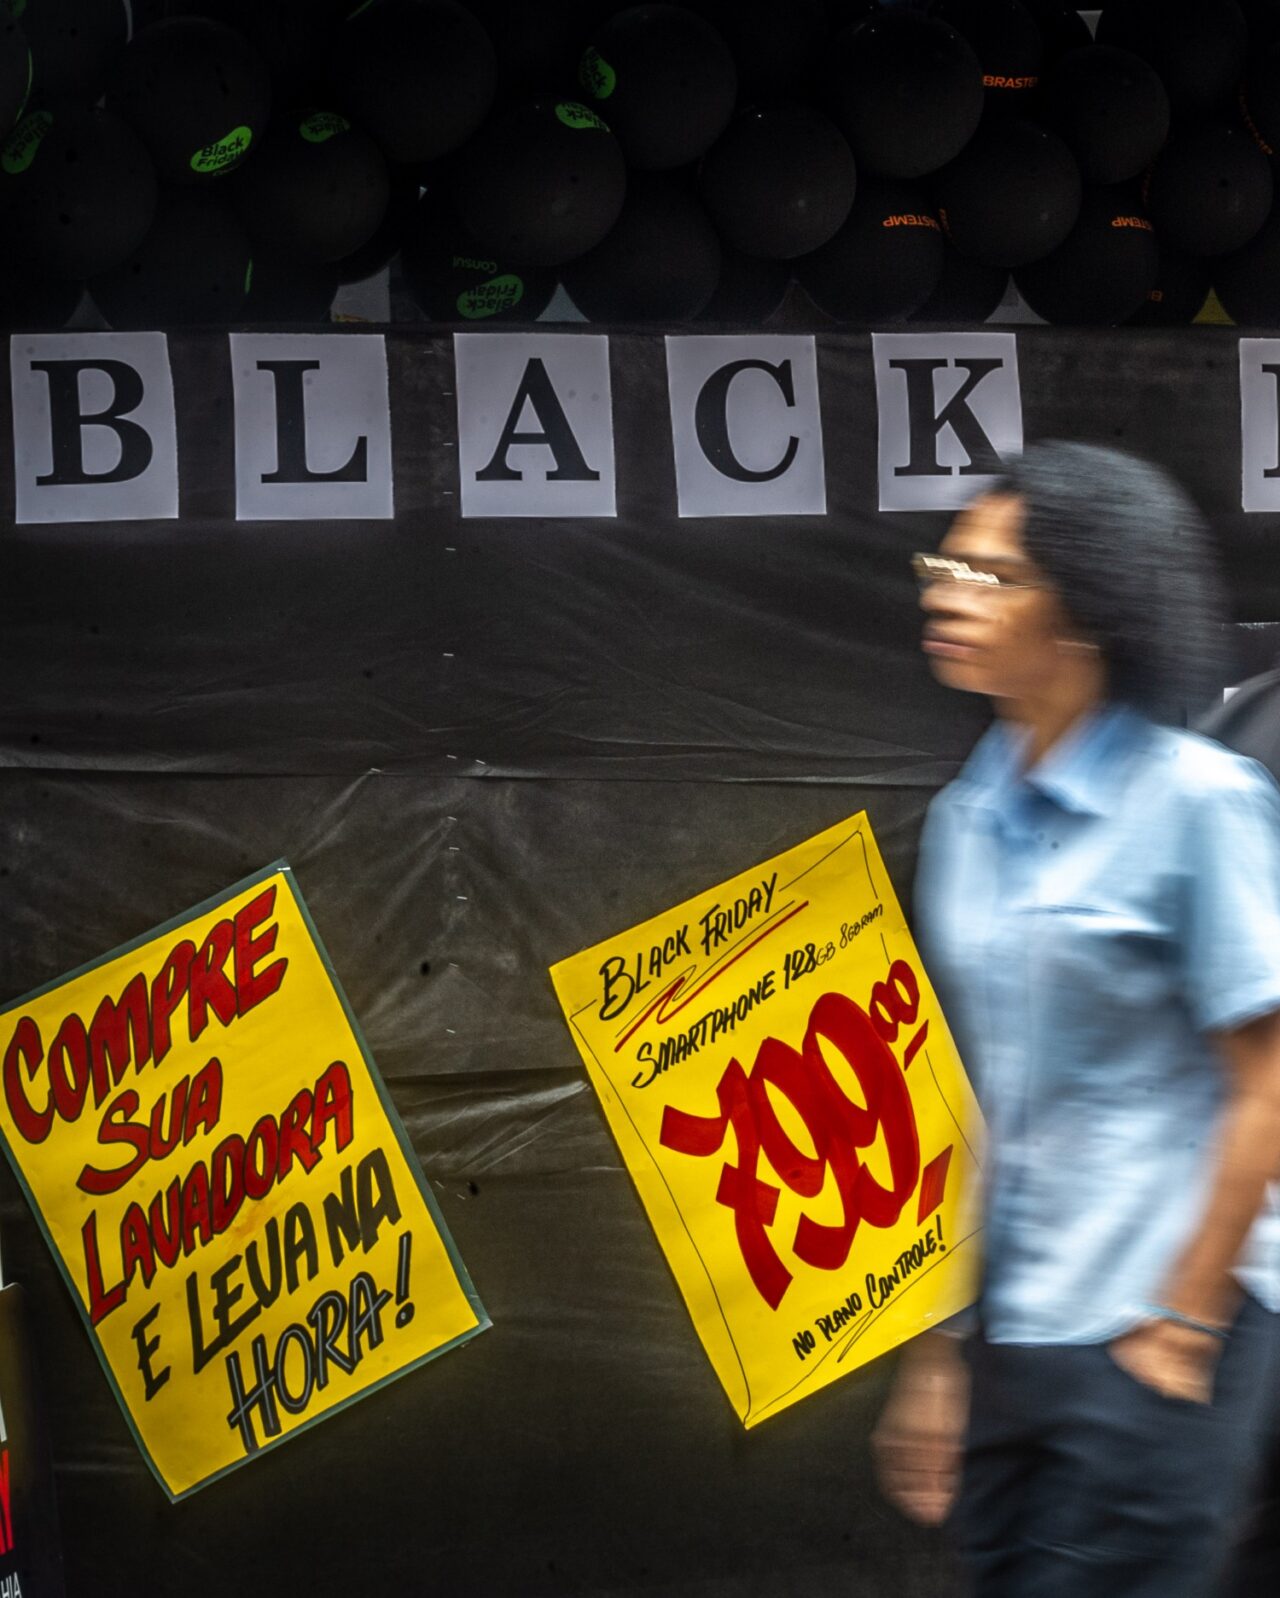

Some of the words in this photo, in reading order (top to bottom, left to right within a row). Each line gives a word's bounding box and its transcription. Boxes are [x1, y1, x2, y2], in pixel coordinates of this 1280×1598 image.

[201, 136, 243, 158] Black
[30, 356, 1005, 486] BLACK
[3, 884, 289, 1144] COMPRE
[600, 925, 691, 1021] BLACK
[699, 872, 778, 956] FRIDAY
[631, 970, 776, 1089] SMARTPHONE
[76, 1056, 223, 1196] SUA
[82, 1060, 354, 1330] LAVADORA
[130, 1303, 173, 1402] E
[187, 1202, 319, 1374] LEVA
[322, 1147, 403, 1268] NA
[227, 1231, 416, 1455] HORA!
[792, 1330, 816, 1361] NO
[815, 1292, 862, 1342] PLANO
